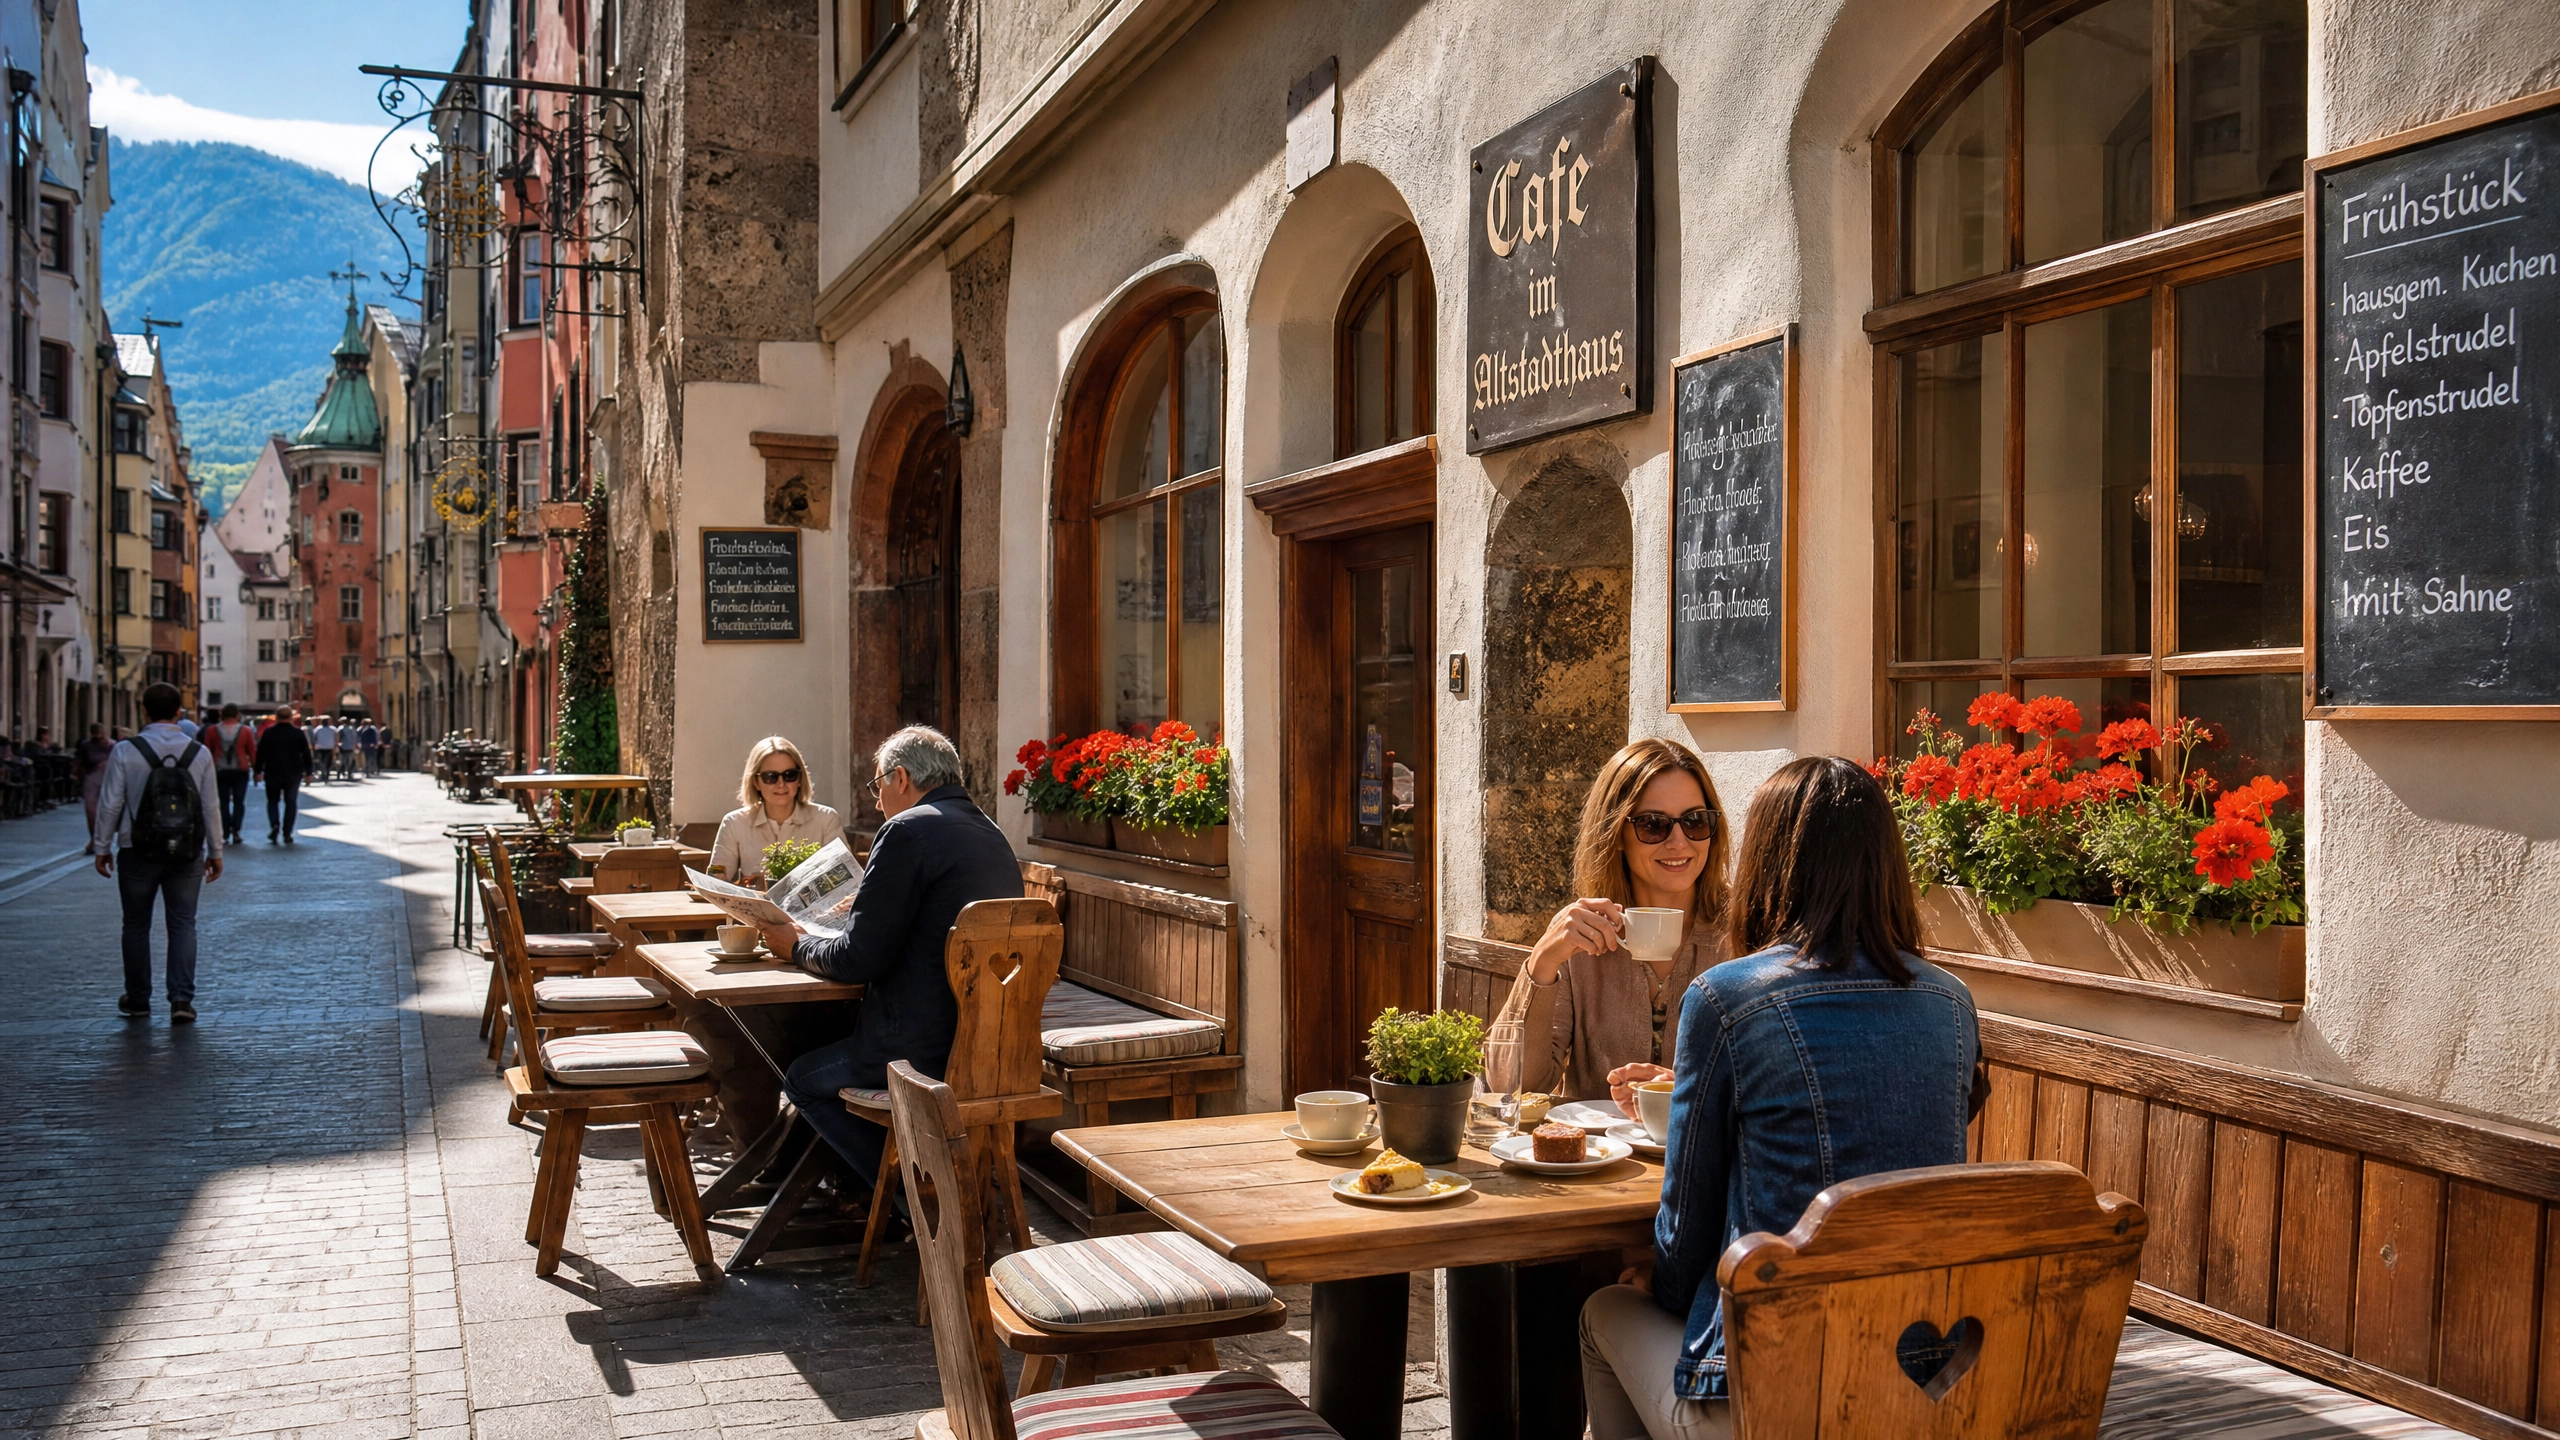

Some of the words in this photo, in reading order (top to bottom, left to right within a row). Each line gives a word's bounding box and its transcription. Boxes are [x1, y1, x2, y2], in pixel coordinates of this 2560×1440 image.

[1486, 135, 1591, 259] Cafe
[2341, 157, 2527, 245] Frühstück
[1528, 268, 1558, 319] im
[2342, 275, 2448, 320] hausgem.
[2462, 246, 2557, 291] Kuchen
[1472, 328, 1625, 414] Altstadthaus
[2343, 307, 2516, 384] Apfelstrudel
[2342, 365, 2520, 440] Topfenstrudel
[2343, 450, 2431, 500] Kaffee
[2343, 514, 2391, 553] Eis
[2421, 574, 2514, 616] Sahne
